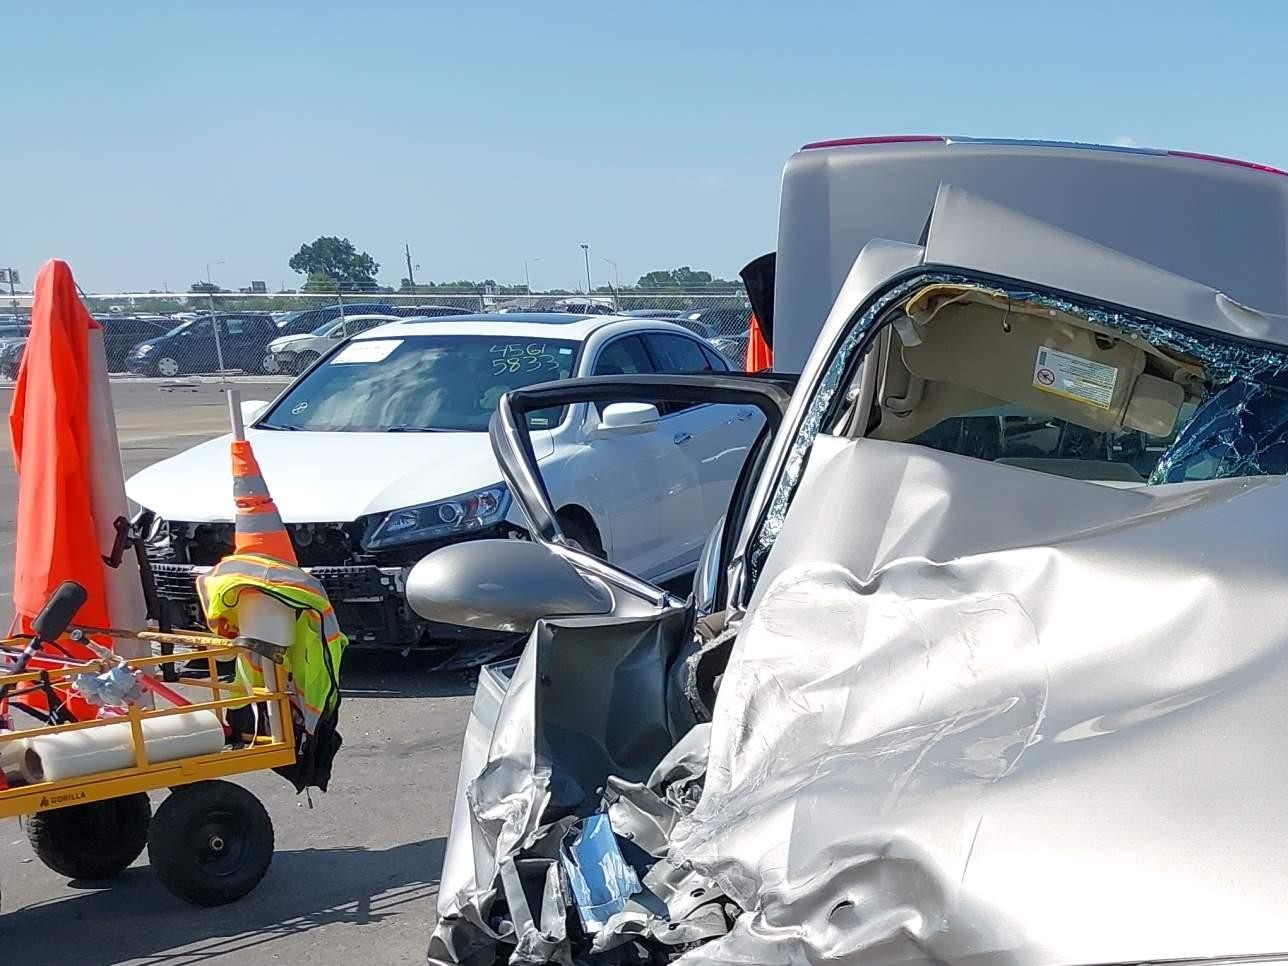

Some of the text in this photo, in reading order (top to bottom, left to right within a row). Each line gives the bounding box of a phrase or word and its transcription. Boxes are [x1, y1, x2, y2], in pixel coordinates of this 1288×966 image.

[489, 343, 546, 357] 4561
[492, 354, 560, 376] 5833
[51, 791, 87, 804] GORILLA
